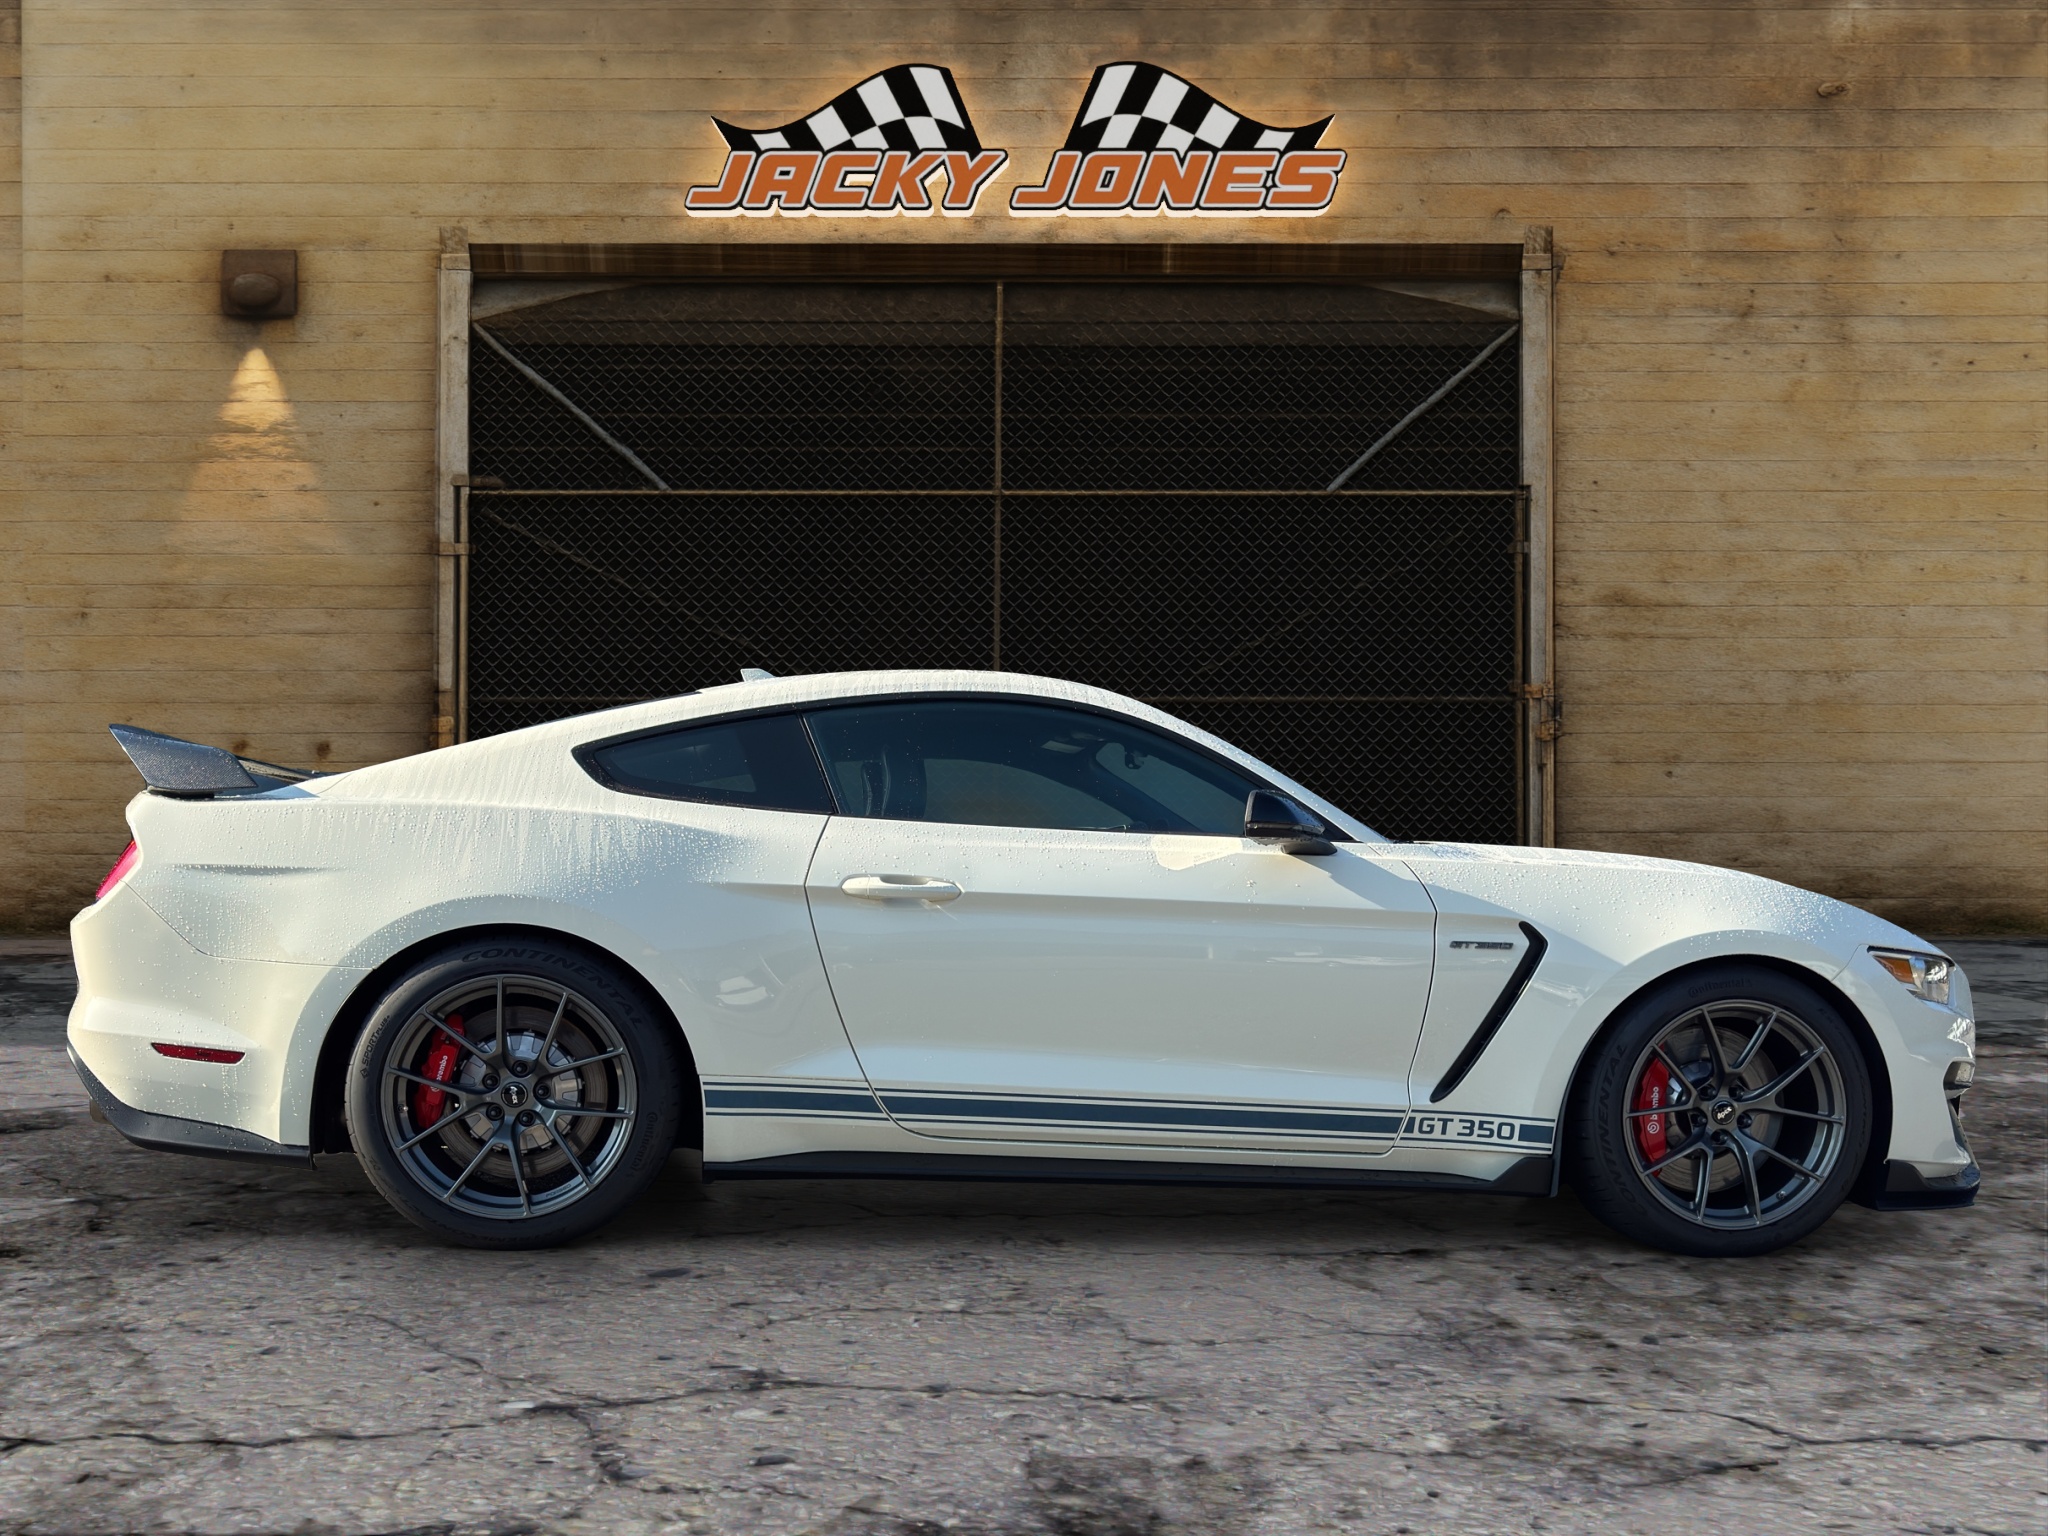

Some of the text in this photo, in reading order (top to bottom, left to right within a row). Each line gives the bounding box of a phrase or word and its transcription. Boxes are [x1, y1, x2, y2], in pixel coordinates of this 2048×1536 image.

[686, 149, 1346, 209] JACKY JONES
[462, 949, 641, 1030] CONTINENTAL
[436, 1054, 449, 1081] rembo
[1649, 1086, 1660, 1121] bmbo
[1417, 1116, 1516, 1141] GT350
